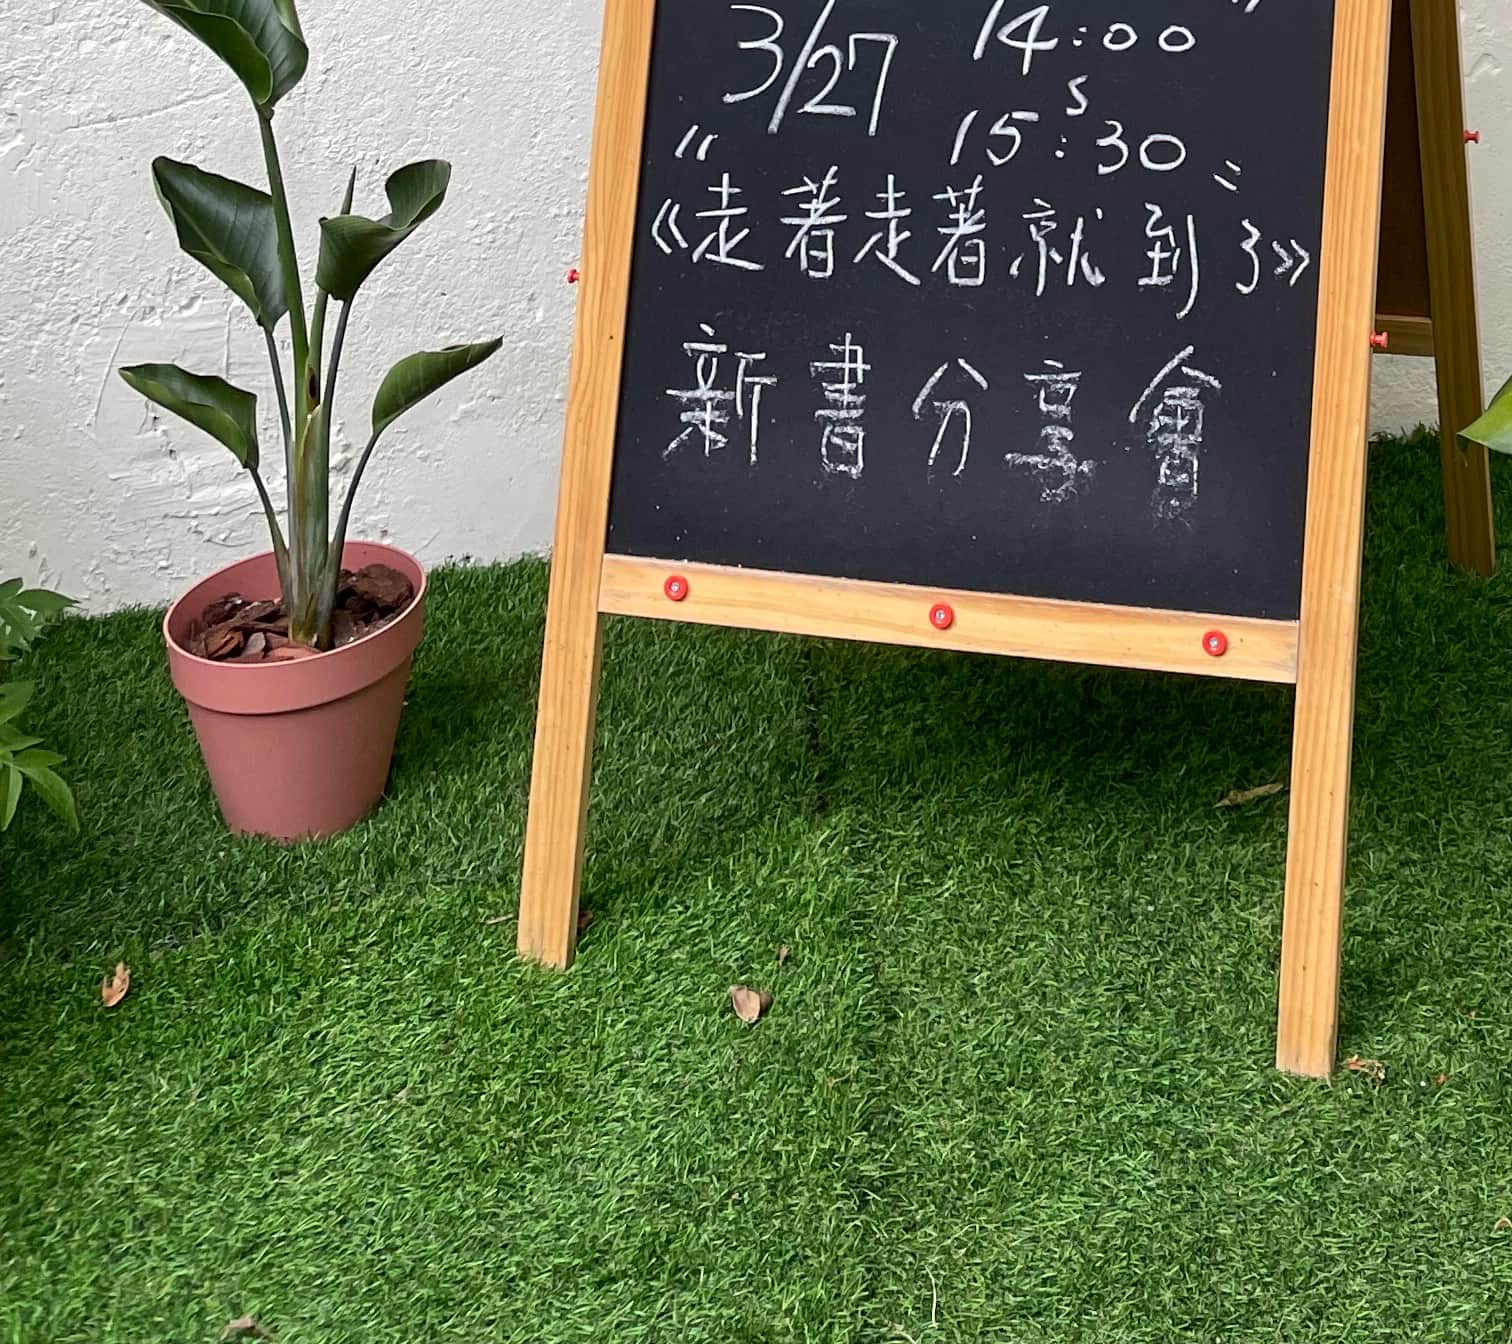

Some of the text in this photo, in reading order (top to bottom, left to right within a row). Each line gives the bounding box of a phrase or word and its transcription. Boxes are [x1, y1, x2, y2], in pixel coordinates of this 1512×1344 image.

[950, 109, 1187, 175] 15:30
[662, 323, 1222, 519] 新書分享會
